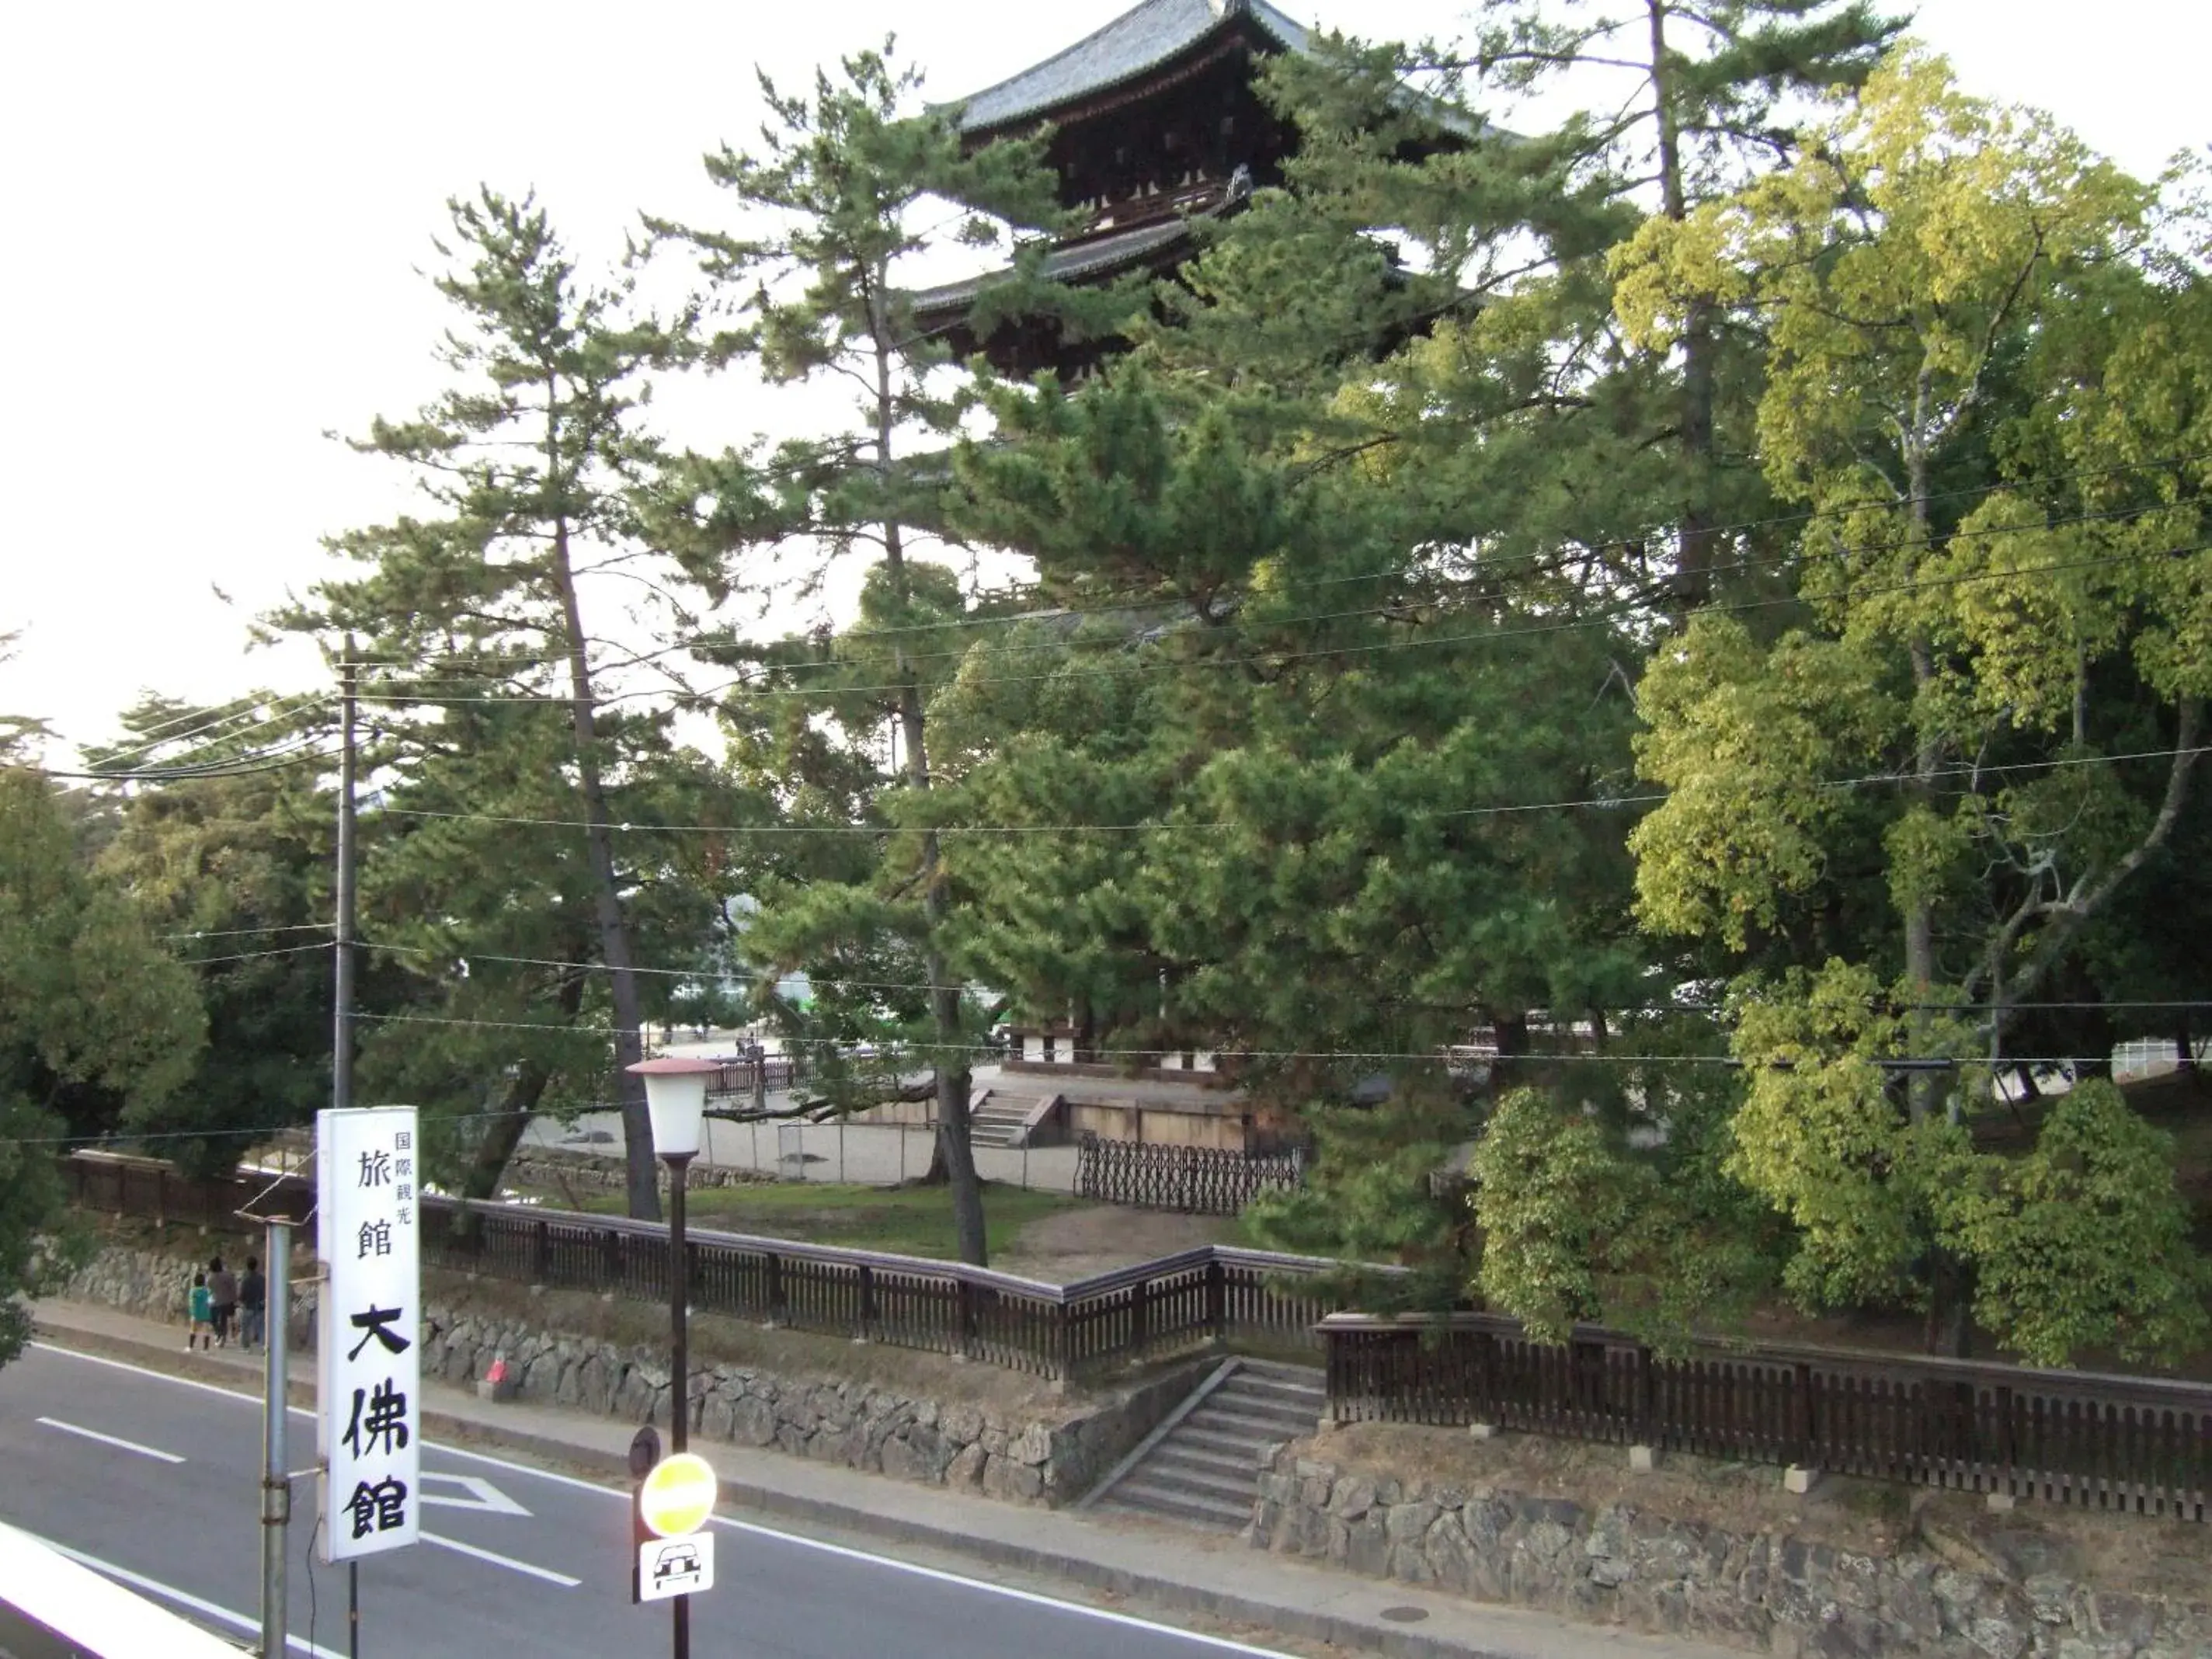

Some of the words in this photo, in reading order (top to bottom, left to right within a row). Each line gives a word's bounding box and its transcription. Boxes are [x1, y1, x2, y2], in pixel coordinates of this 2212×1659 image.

[357, 1149, 391, 1259] 旅館
[342, 1303, 411, 1539] 大佛館
